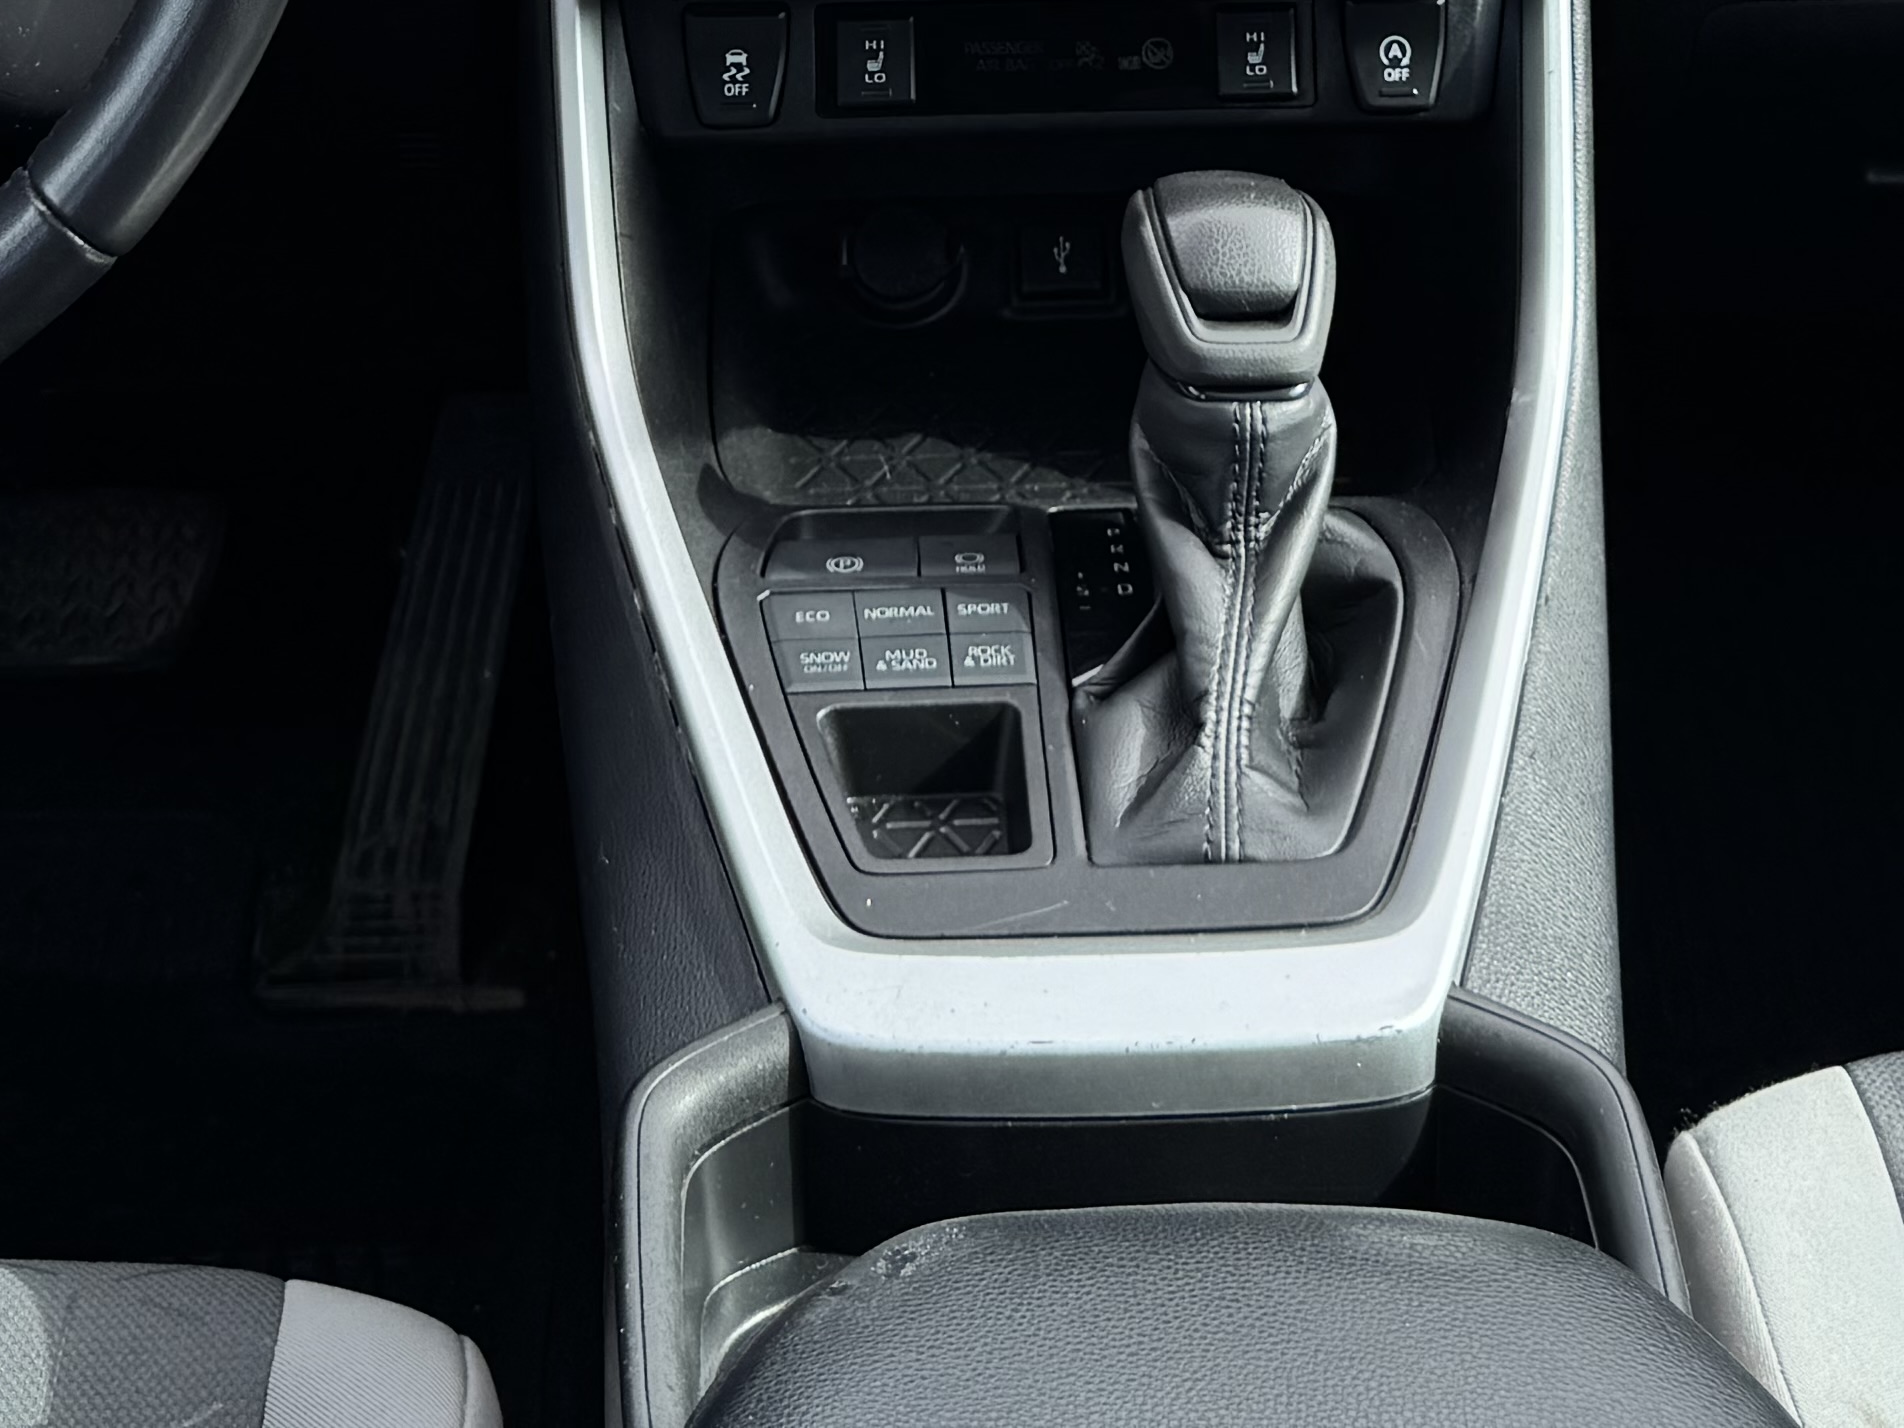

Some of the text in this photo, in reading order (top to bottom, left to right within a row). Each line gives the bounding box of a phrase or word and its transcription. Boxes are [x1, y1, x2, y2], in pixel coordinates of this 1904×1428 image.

[1246, 32, 1265, 42] HI
[865, 40, 884, 50] HI
[1246, 65, 1267, 76] LO
[1383, 67, 1410, 82] OFF
[865, 72, 886, 83] LO
[724, 83, 750, 96] OFF
[1113, 561, 1130, 573] N
[1117, 583, 1133, 595] D
[864, 605, 934, 620] NORMAL
[957, 603, 1009, 616] SPORT
[796, 610, 830, 623] ECO
[885, 648, 928, 661] MUD
[968, 645, 1012, 657] ROCK
[800, 651, 850, 664] SNOW
[980, 655, 1015, 667] DIRT
[891, 658, 938, 671] SAND
